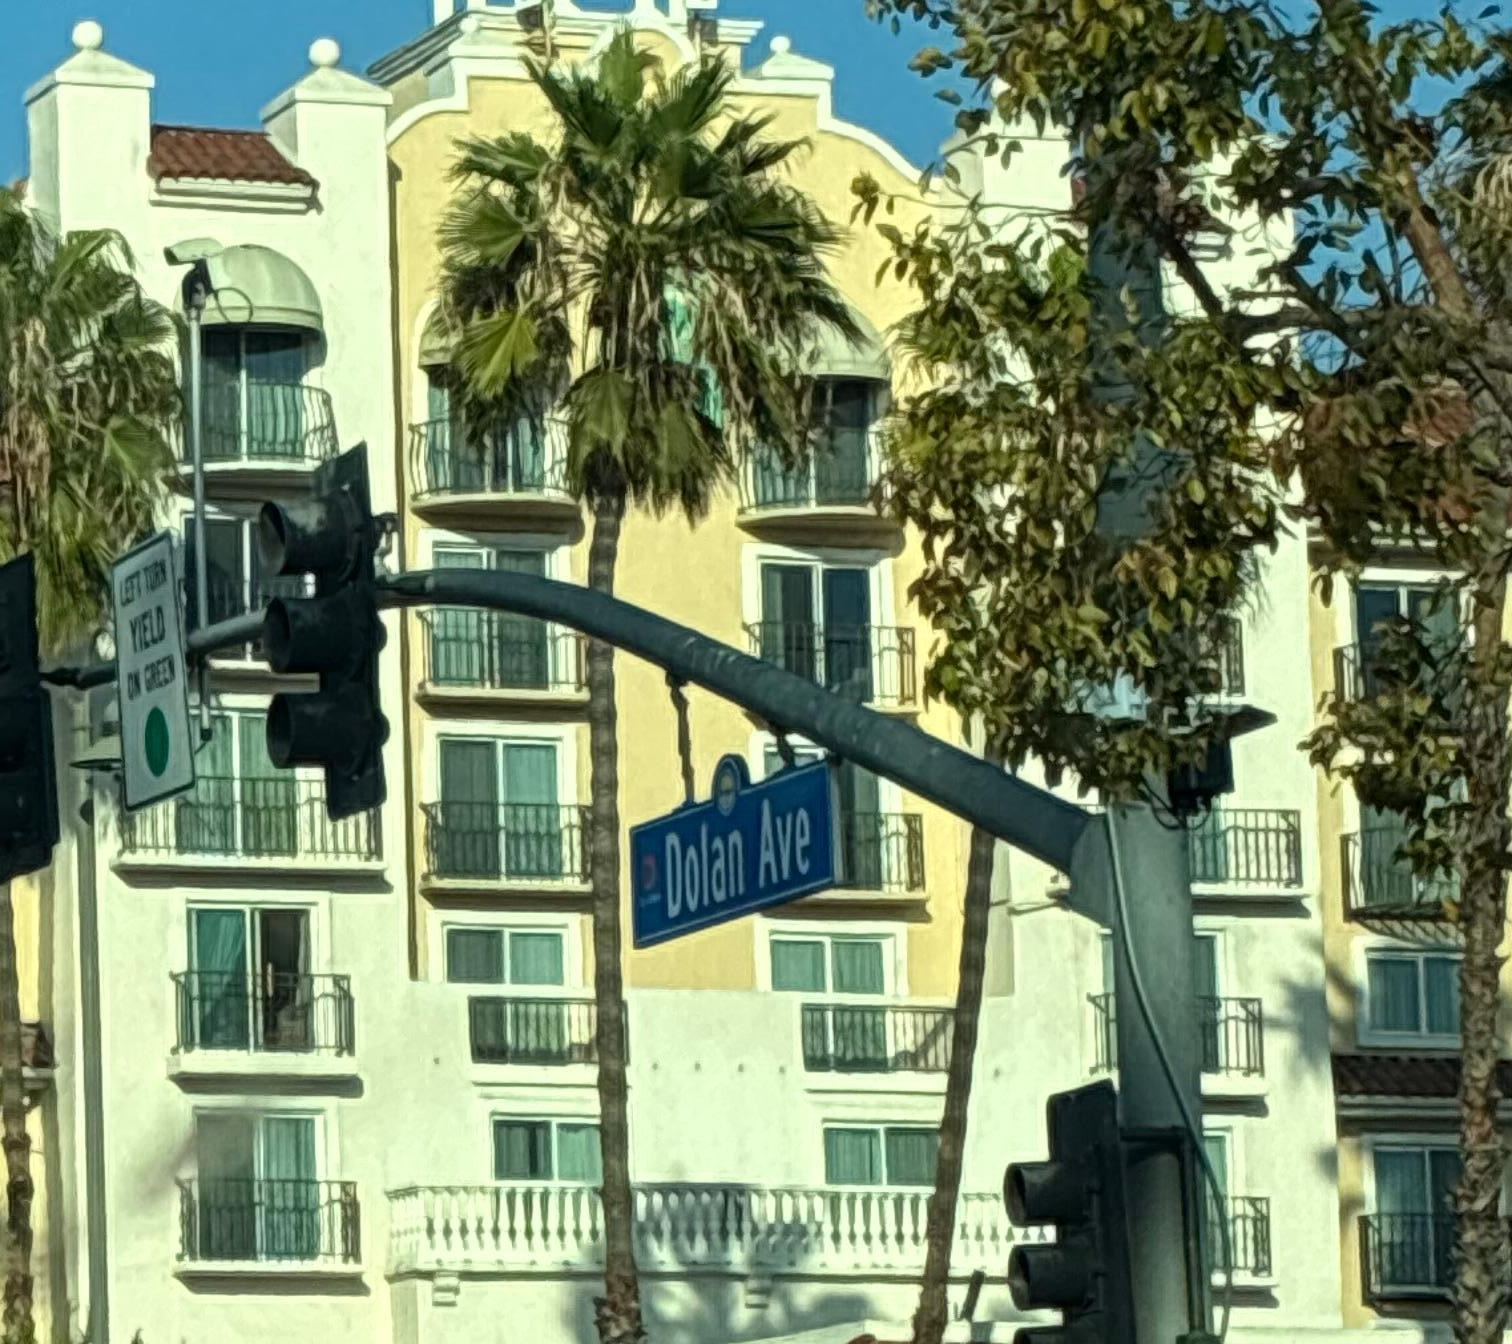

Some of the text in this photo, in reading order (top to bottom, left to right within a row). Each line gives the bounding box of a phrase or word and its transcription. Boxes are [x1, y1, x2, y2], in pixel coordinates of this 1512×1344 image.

[120, 560, 168, 606] LEFT TURN
[129, 606, 166, 653] YIELD
[127, 654, 175, 700] ON GREEN
[665, 821, 744, 919] Dolan
[758, 798, 810, 888] Ave
